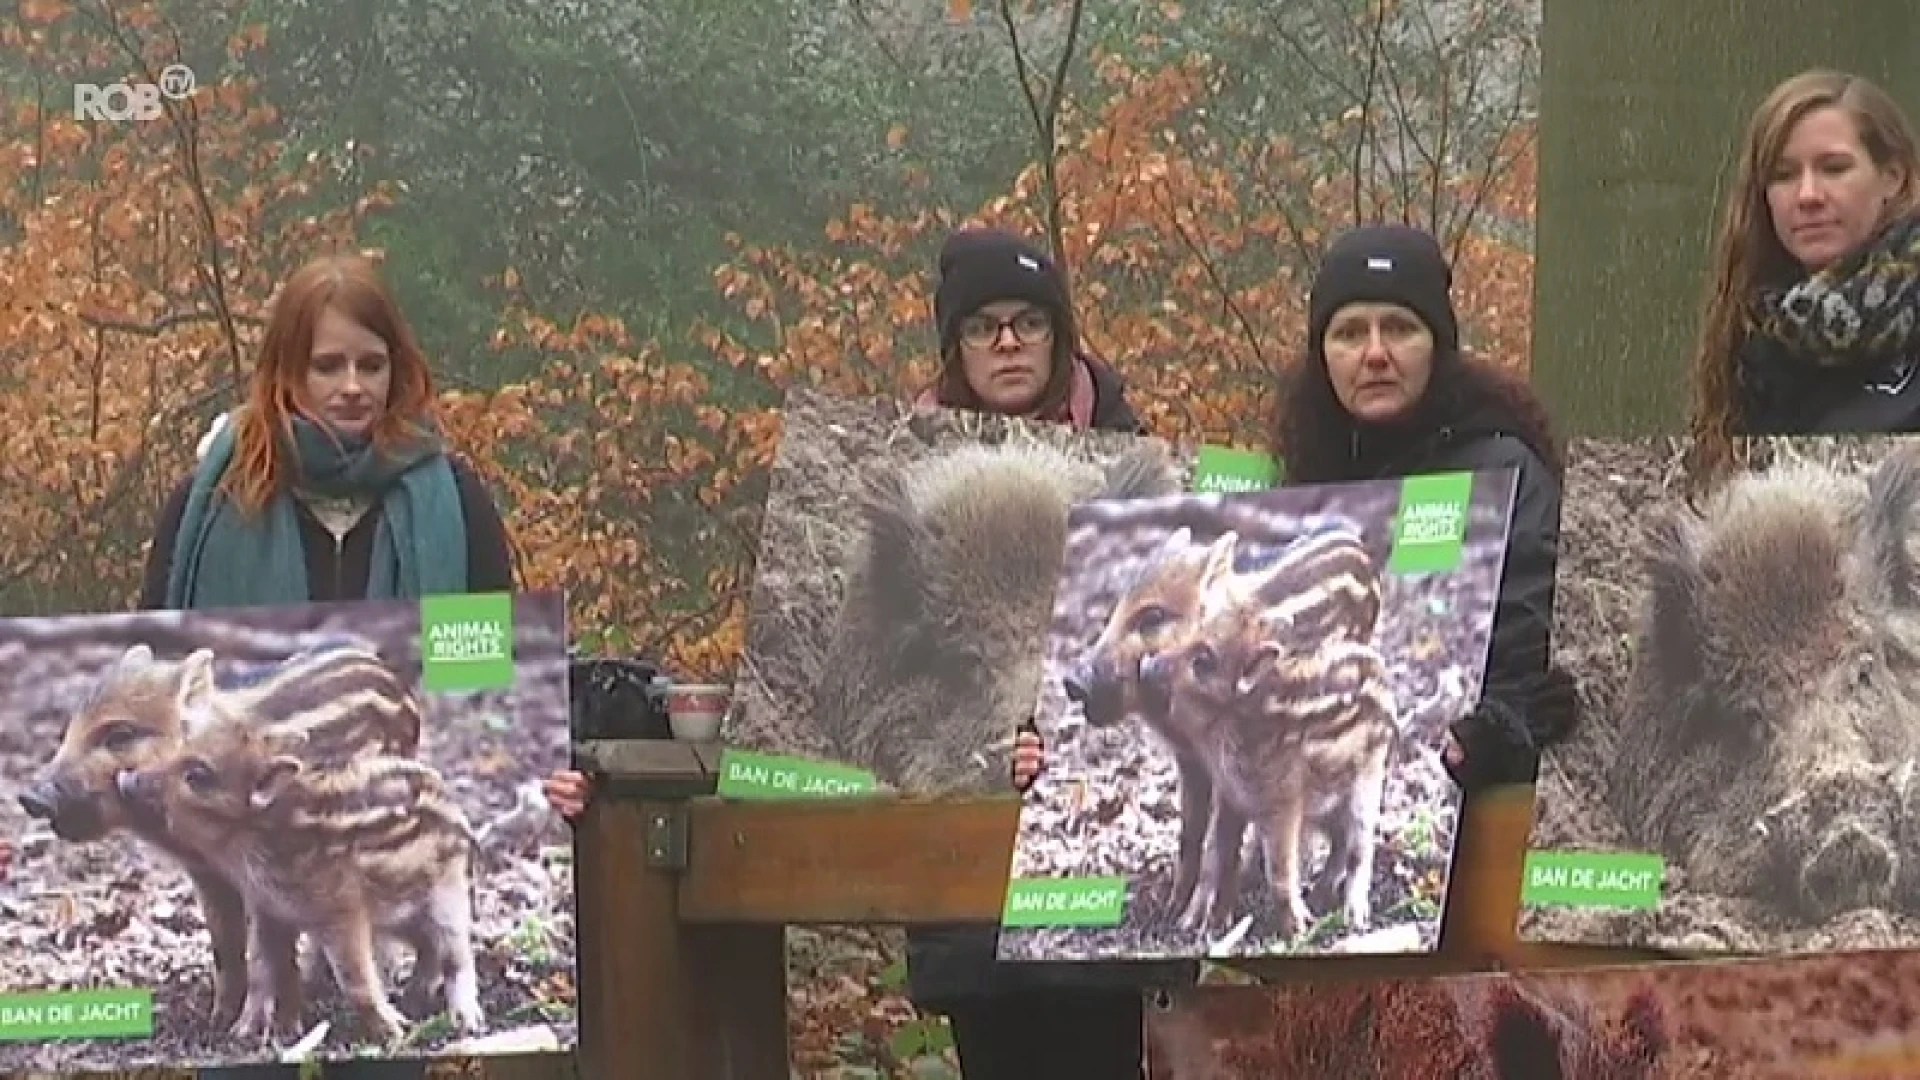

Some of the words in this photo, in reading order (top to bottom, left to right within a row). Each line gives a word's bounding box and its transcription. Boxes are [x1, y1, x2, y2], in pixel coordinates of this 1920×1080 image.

[1403, 502, 1461, 521] ANIMAL
[1403, 519, 1457, 538] RIGHTS
[429, 621, 504, 640] ANIMAL
[433, 639, 501, 657] RIGHTS
[729, 762, 769, 785] BAN
[772, 769, 798, 792] DE
[801, 775, 862, 796] JACHT
[1532, 866, 1568, 888] BAN
[1571, 868, 1595, 889] DE
[1597, 869, 1652, 891] JACHT
[1012, 892, 1045, 911] BAN
[1046, 891, 1067, 910] DE
[1070, 889, 1117, 910] JACHT
[1, 1006, 42, 1025] BAN
[47, 1004, 73, 1023] DE
[79, 1002, 141, 1021] JACHT
